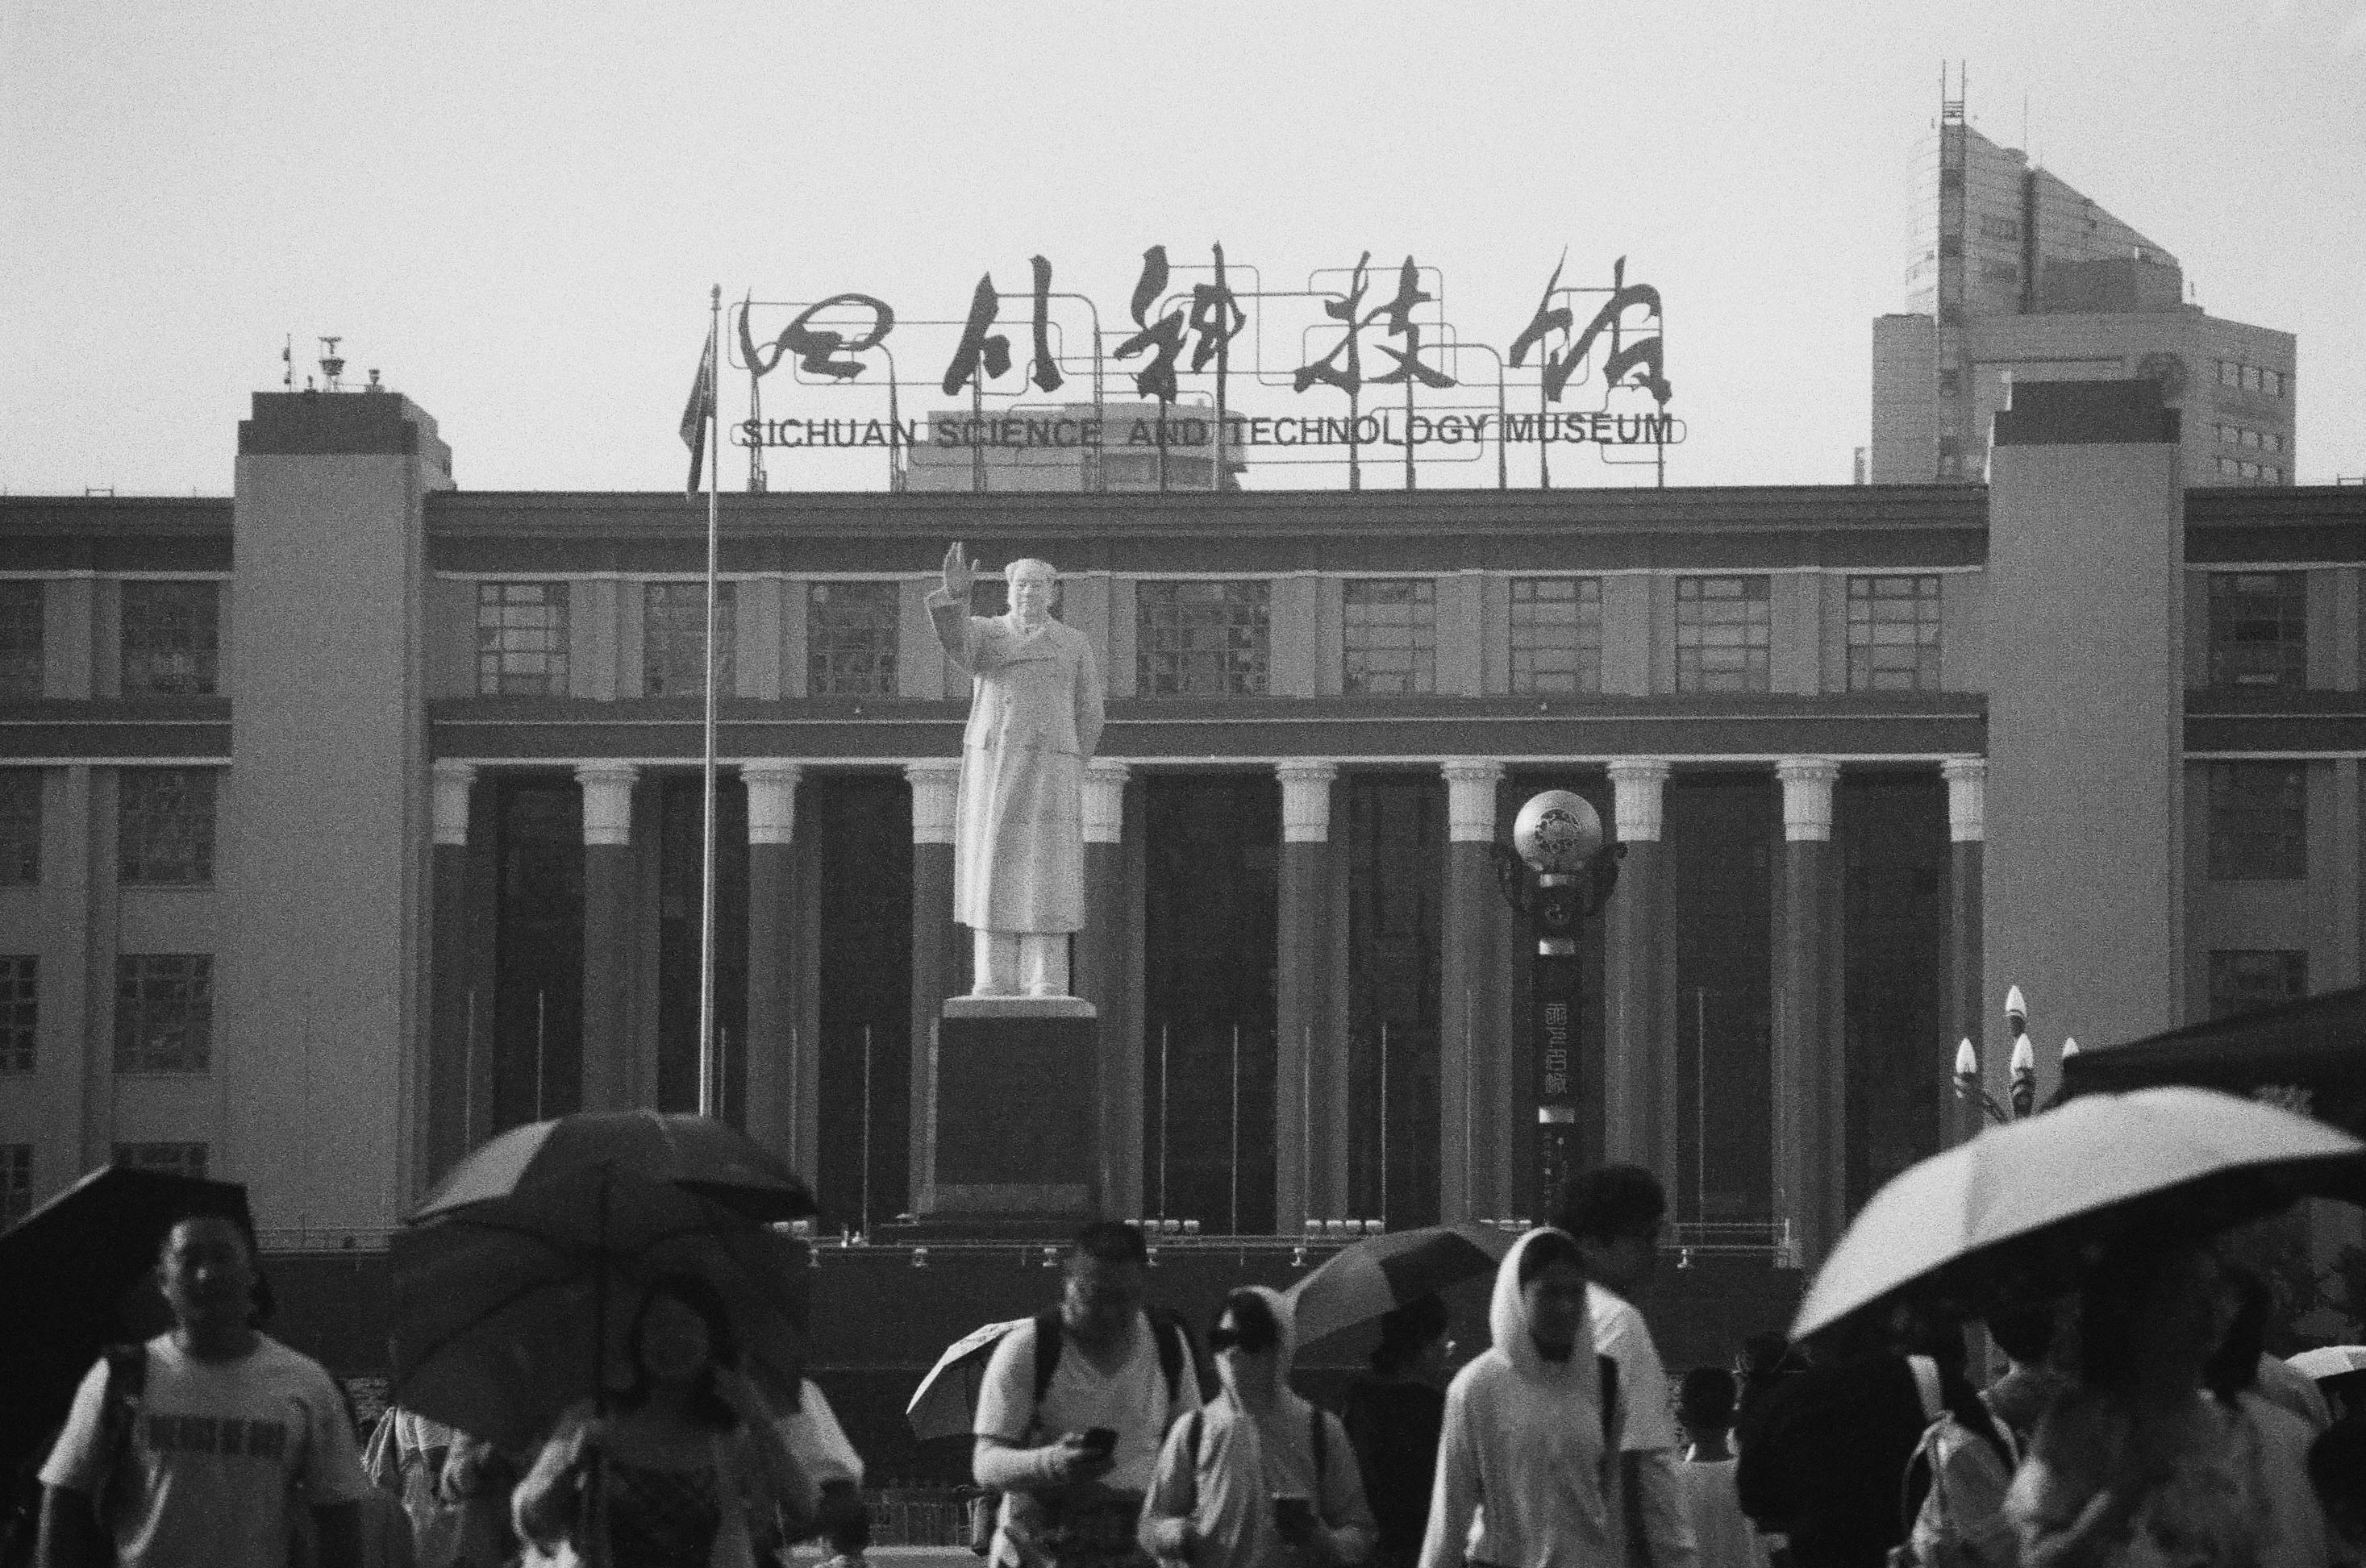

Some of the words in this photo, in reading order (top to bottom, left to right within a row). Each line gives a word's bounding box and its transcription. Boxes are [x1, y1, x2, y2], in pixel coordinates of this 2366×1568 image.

[741, 419, 916, 448] SICHUAN
[937, 419, 1102, 448] SCIENCE
[1129, 418, 1206, 447] AND
[1232, 414, 1485, 445] TECHNOLOGY
[1506, 413, 1673, 444] MUSEUM
